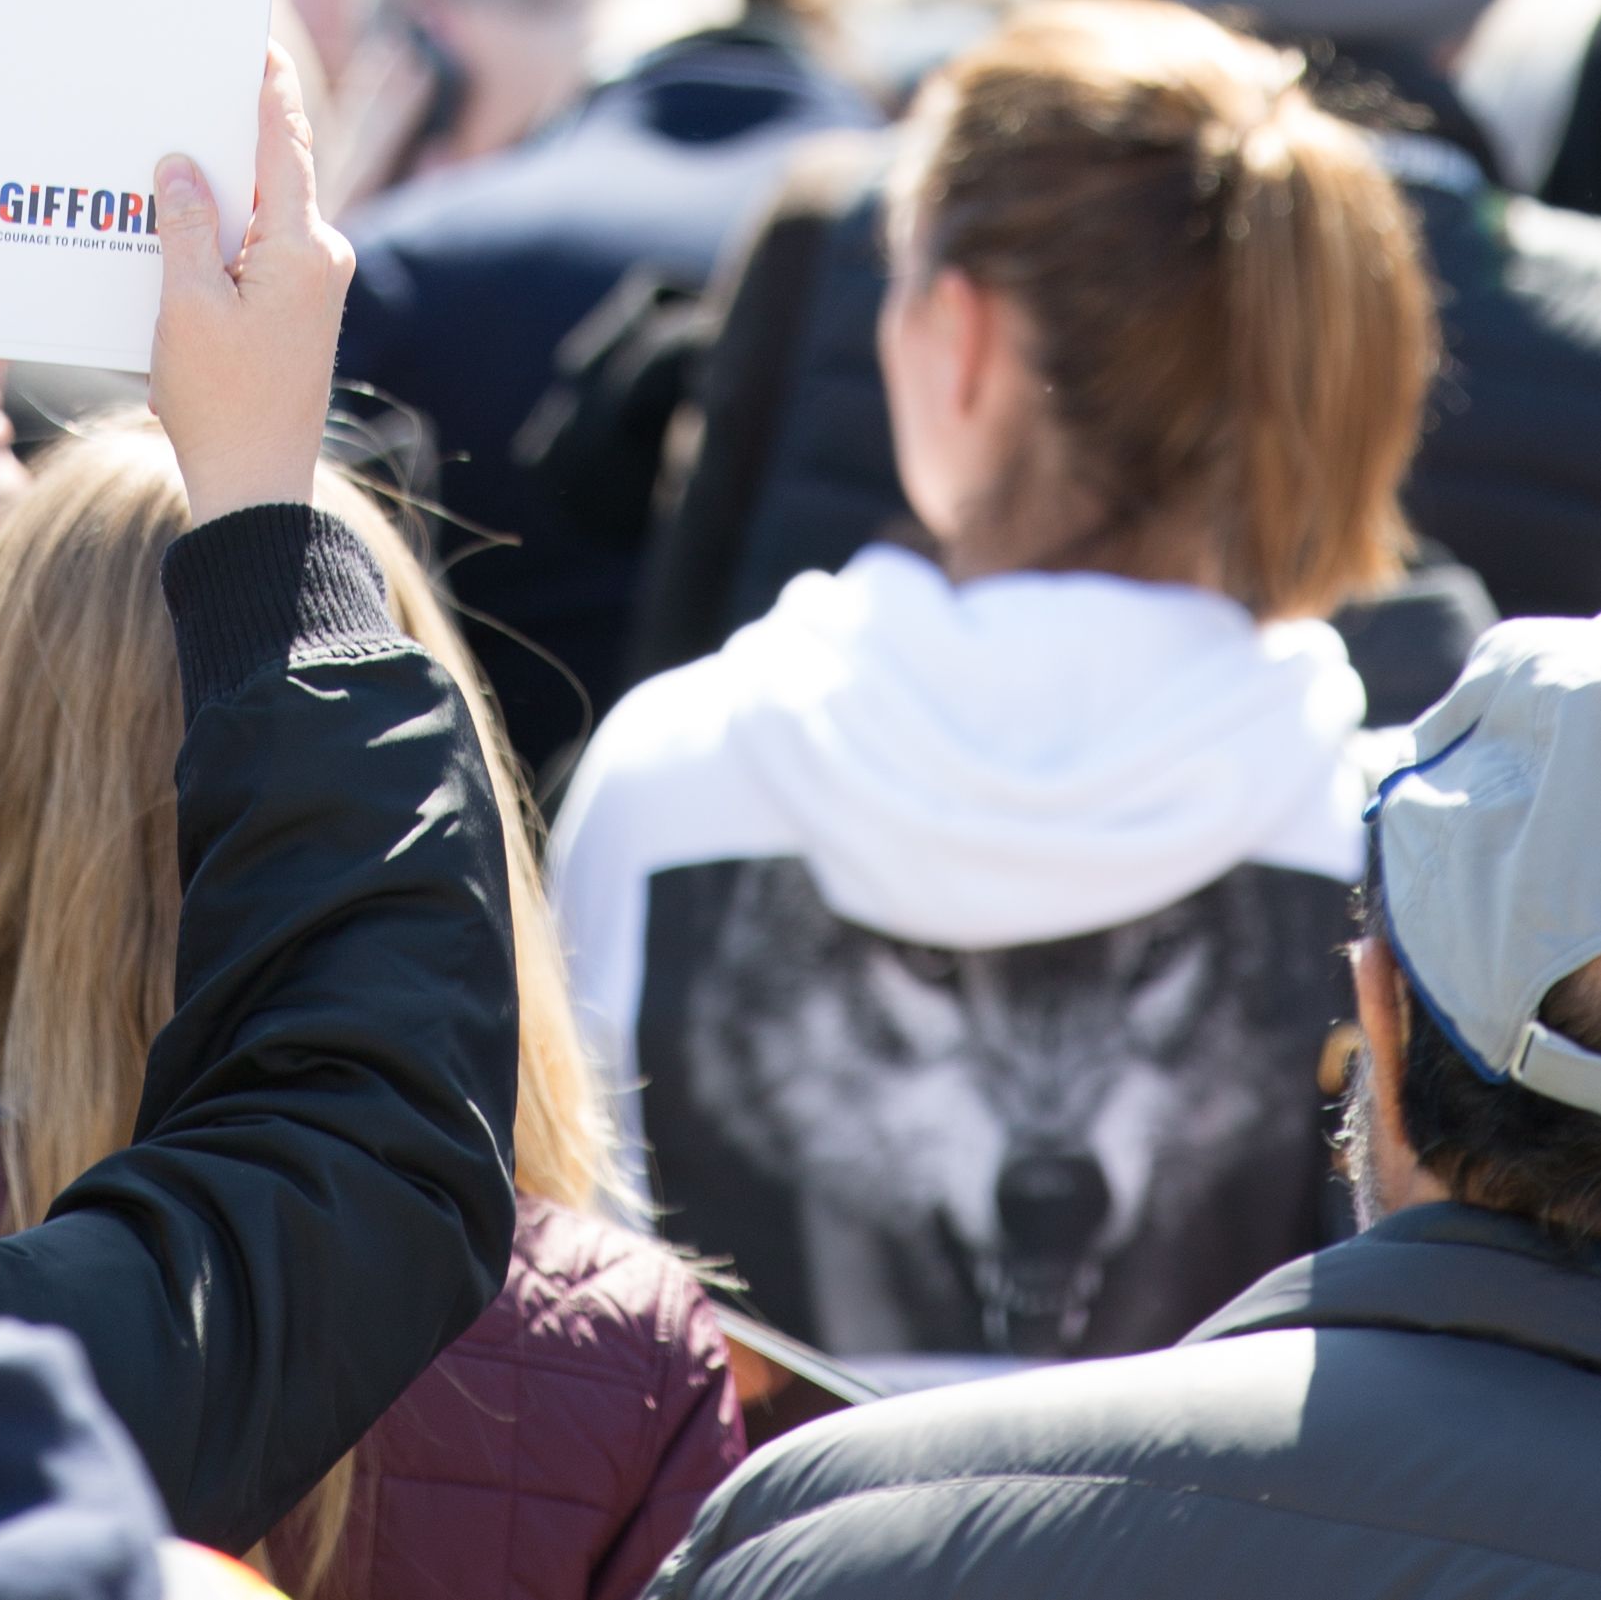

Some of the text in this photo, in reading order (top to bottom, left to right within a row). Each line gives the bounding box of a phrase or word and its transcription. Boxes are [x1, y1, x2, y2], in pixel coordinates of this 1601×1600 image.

[55, 236, 69, 247] TO
[72, 238, 106, 250] FIGHT
[109, 241, 133, 252] GUN
[136, 243, 162, 255] VIOL
